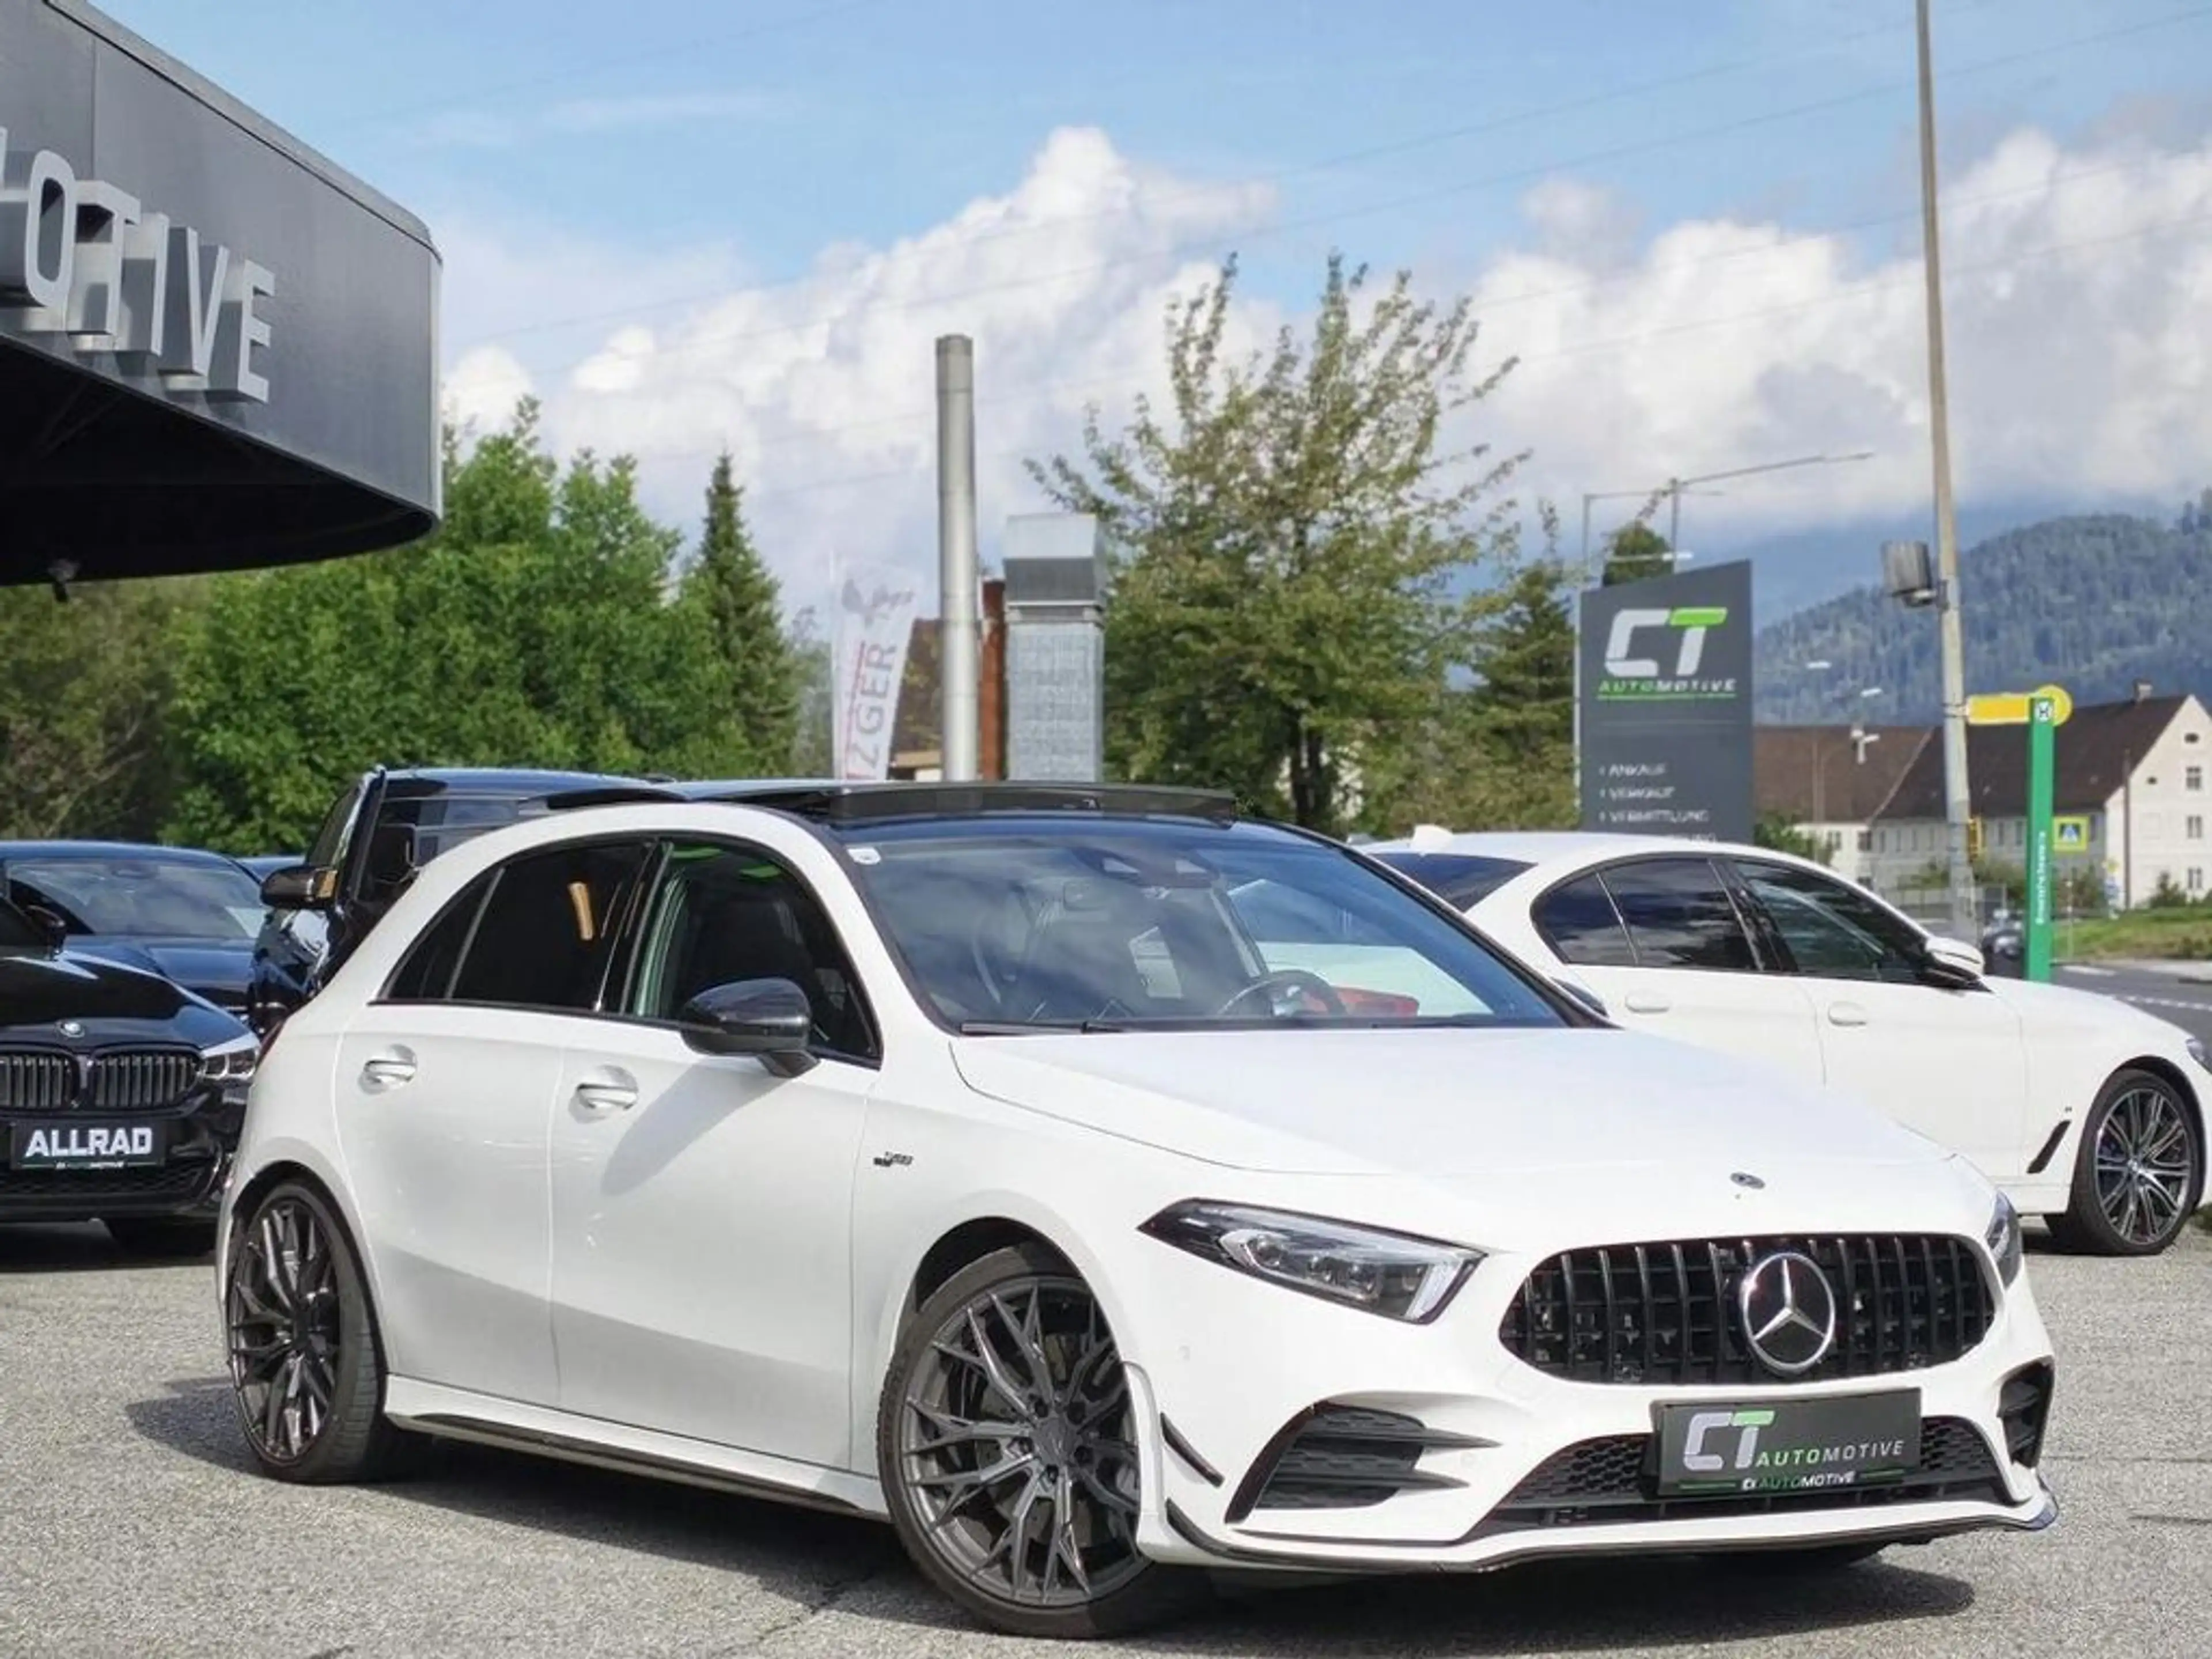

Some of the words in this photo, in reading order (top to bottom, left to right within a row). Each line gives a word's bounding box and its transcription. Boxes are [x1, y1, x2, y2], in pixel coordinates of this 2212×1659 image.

[0, 125, 275, 404] OTIVE
[1604, 607, 1728, 677] CT
[1598, 679, 1737, 692] AUTOMOTIVE
[25, 1127, 153, 1157] ALLRAD
[1683, 1410, 1775, 1471] CT
[1755, 1440, 1904, 1468] AUTOMOTIVE
[1758, 1471, 1856, 1490] AUTOMOTIVE
